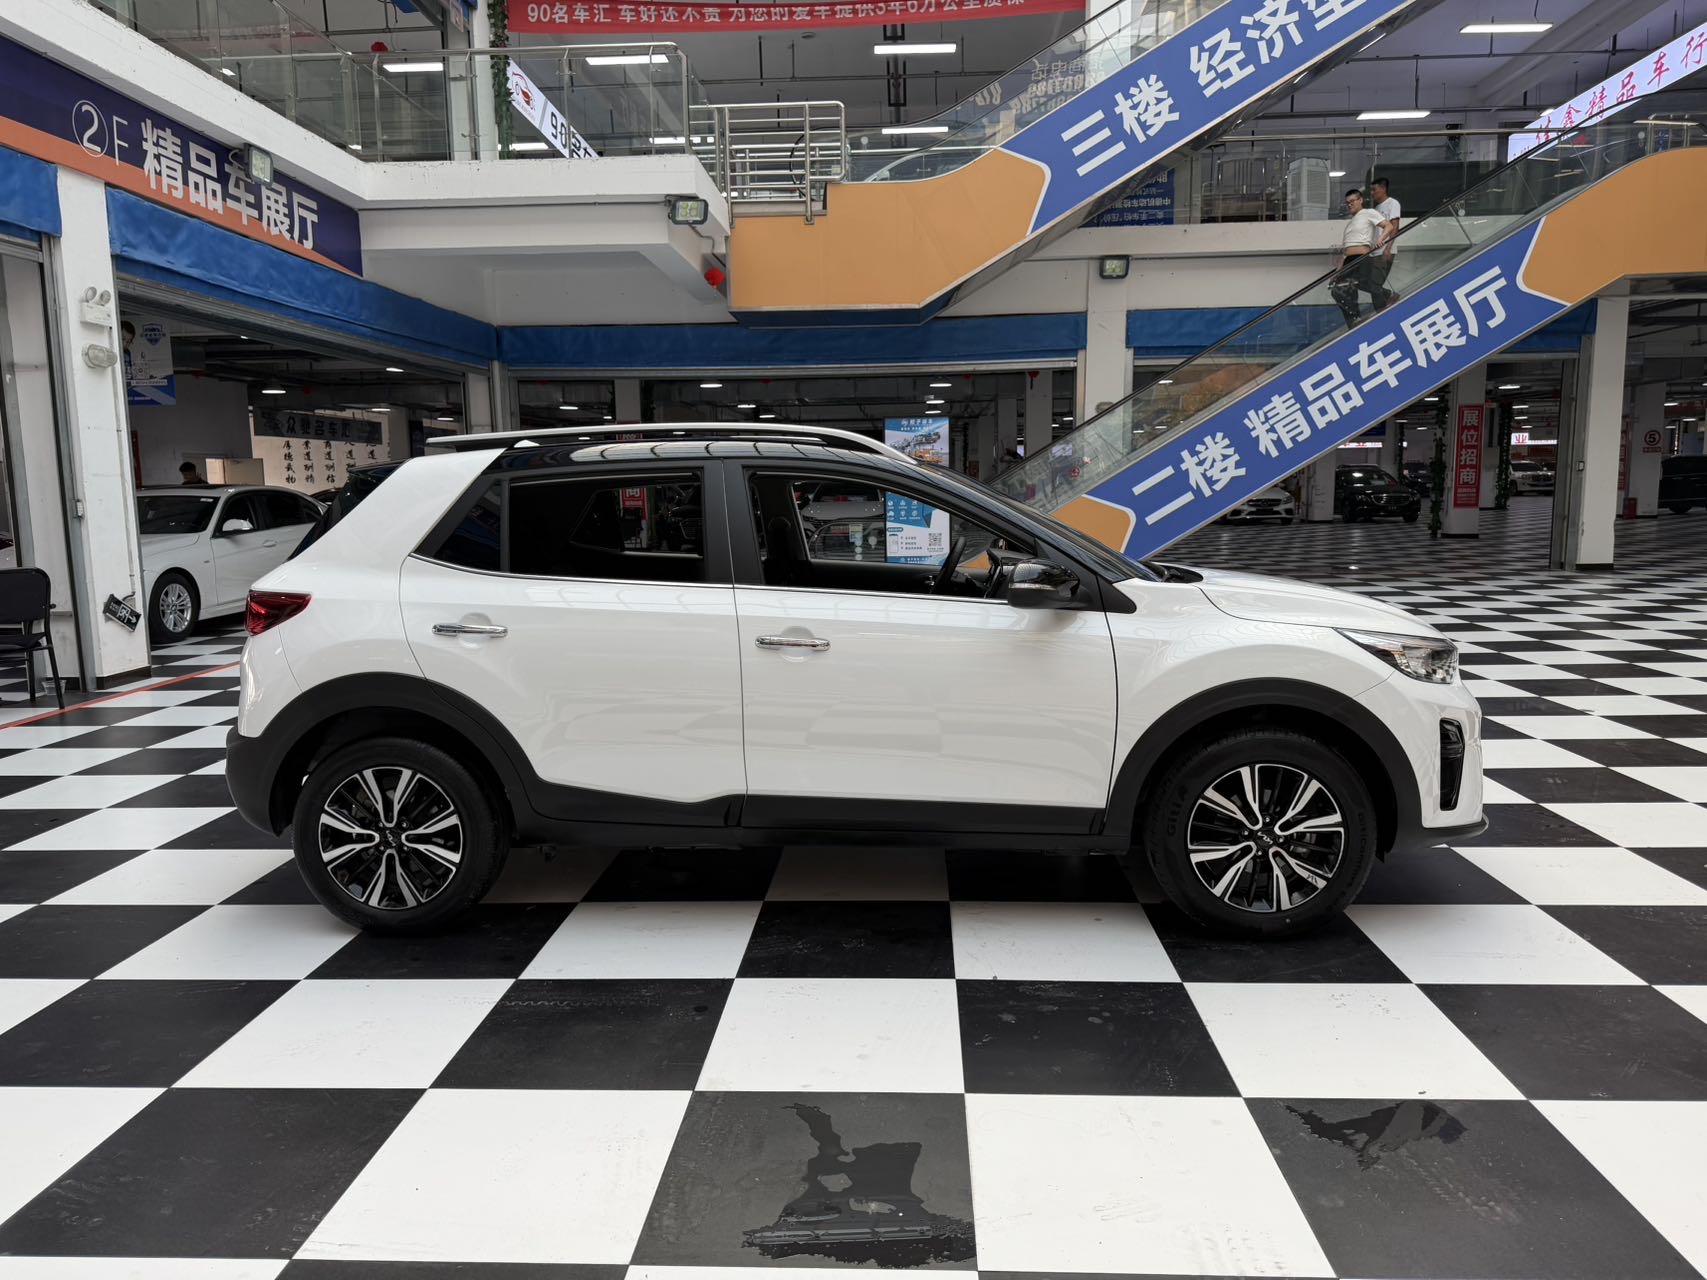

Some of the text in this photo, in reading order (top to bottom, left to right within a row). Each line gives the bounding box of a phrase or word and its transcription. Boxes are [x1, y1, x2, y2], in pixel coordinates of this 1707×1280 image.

[527, 4, 612, 24] 90名车汇
[728, 0, 1026, 23] 为您的爱车提供3年6万公里
[1061, 74, 1180, 177] 三楼
[141, 118, 319, 250] 精品车展厅
[1132, 265, 1508, 526] 二楼 精品车展厅
[1460, 410, 1479, 484] 展位招商
